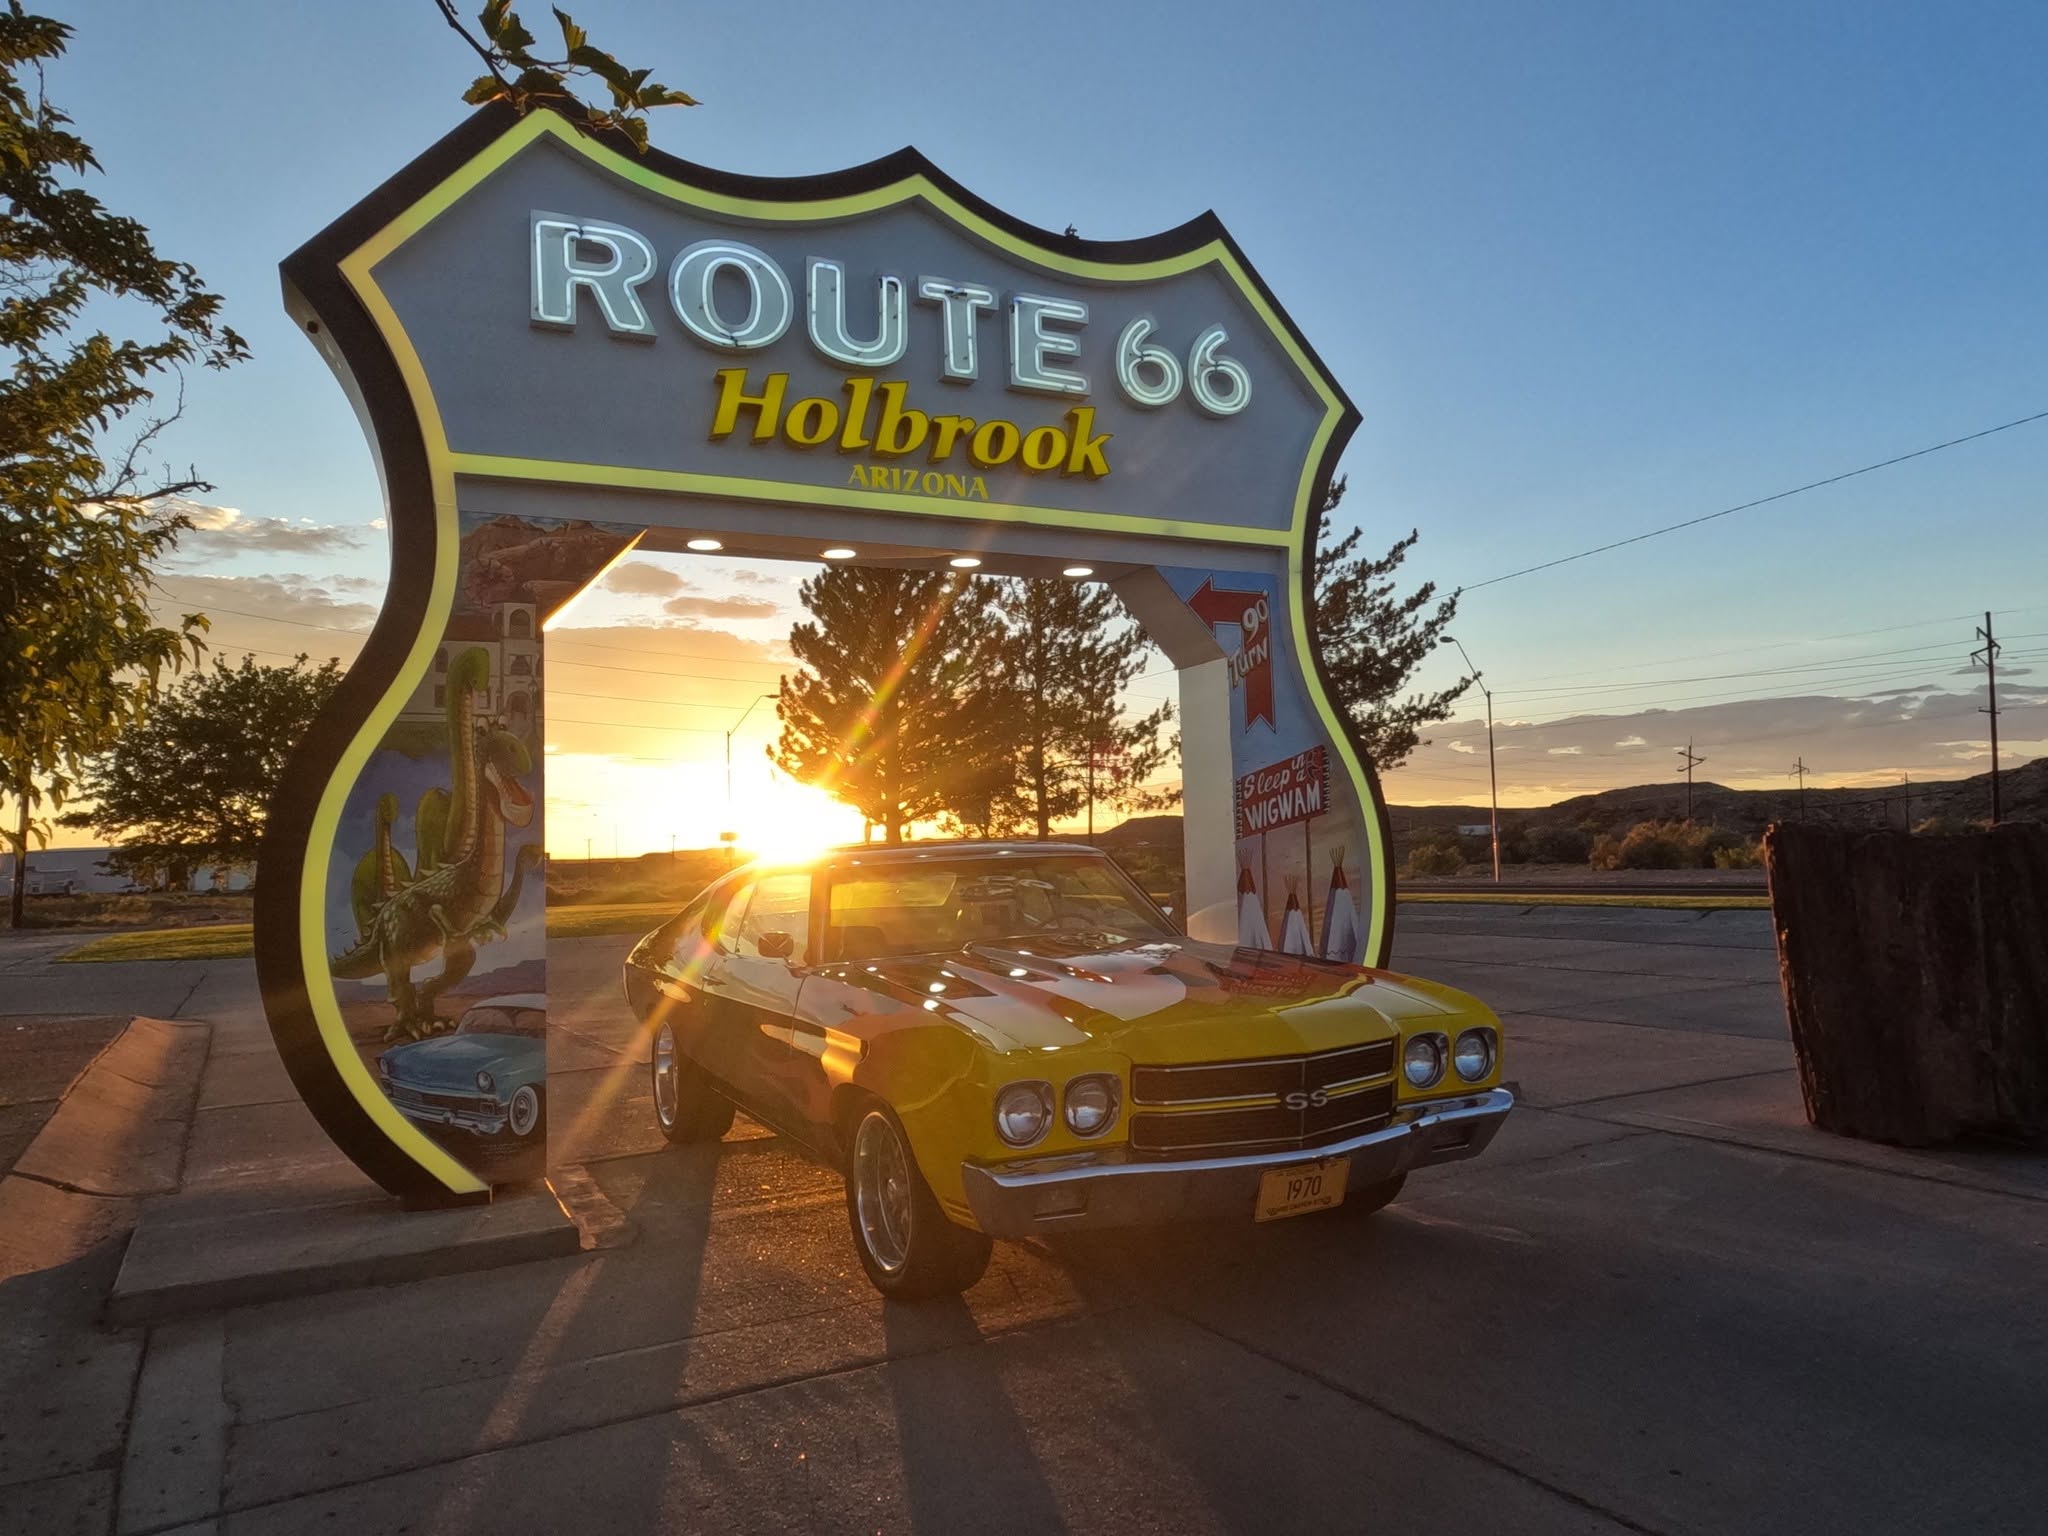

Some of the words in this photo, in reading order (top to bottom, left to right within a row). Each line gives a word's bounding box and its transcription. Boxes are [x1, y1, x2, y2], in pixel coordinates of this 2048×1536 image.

[530, 209, 1092, 396] ROUTE
[1115, 313, 1253, 417] 66
[708, 367, 1114, 480] Holbrook
[847, 463, 990, 500] ARIZONA
[1291, 753, 1305, 770] in
[1296, 768, 1307, 783] a
[1243, 771, 1291, 800] Sleep
[1244, 780, 1321, 831] WIGWAM
[1286, 1089, 1328, 1110] SS
[1287, 1175, 1322, 1201] 1970
